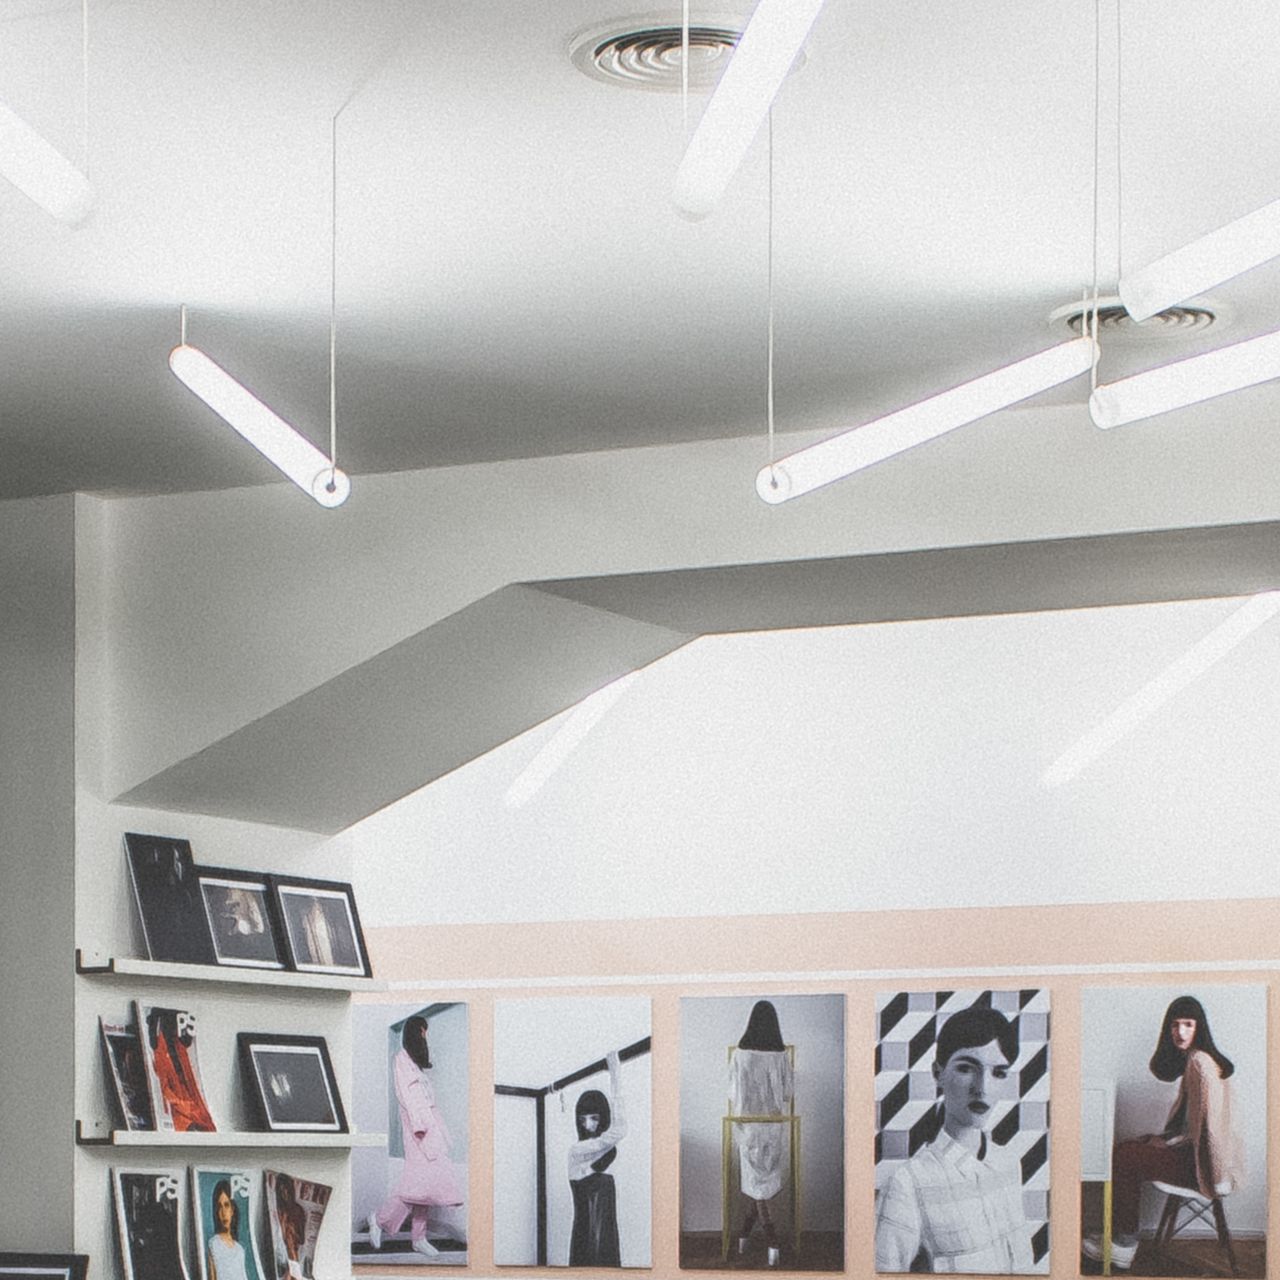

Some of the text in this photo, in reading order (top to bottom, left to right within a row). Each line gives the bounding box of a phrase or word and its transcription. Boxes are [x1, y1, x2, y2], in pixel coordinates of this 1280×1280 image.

[176, 1012, 197, 1038] PS
[156, 1175, 179, 1203] PS
[230, 1174, 251, 1200] PS
